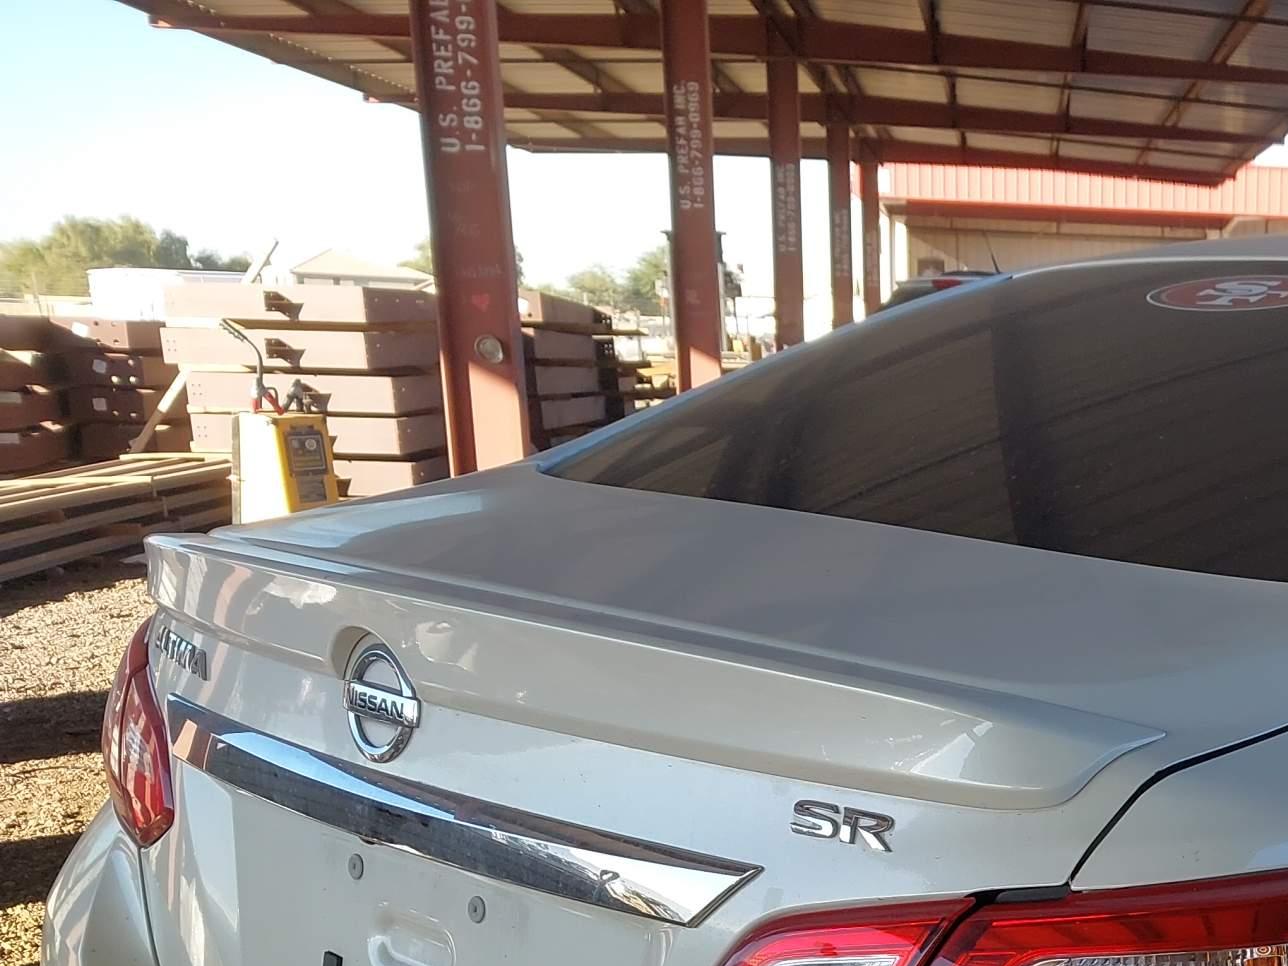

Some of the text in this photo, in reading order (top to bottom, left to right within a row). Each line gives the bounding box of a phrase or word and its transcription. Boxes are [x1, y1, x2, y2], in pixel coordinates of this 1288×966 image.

[455, 0, 486, 151] 1-866-799-
[438, 106, 461, 152] U.S.
[679, 180, 692, 209] U.S.
[346, 685, 405, 720] NISSAN
[789, 799, 896, 853] SR
